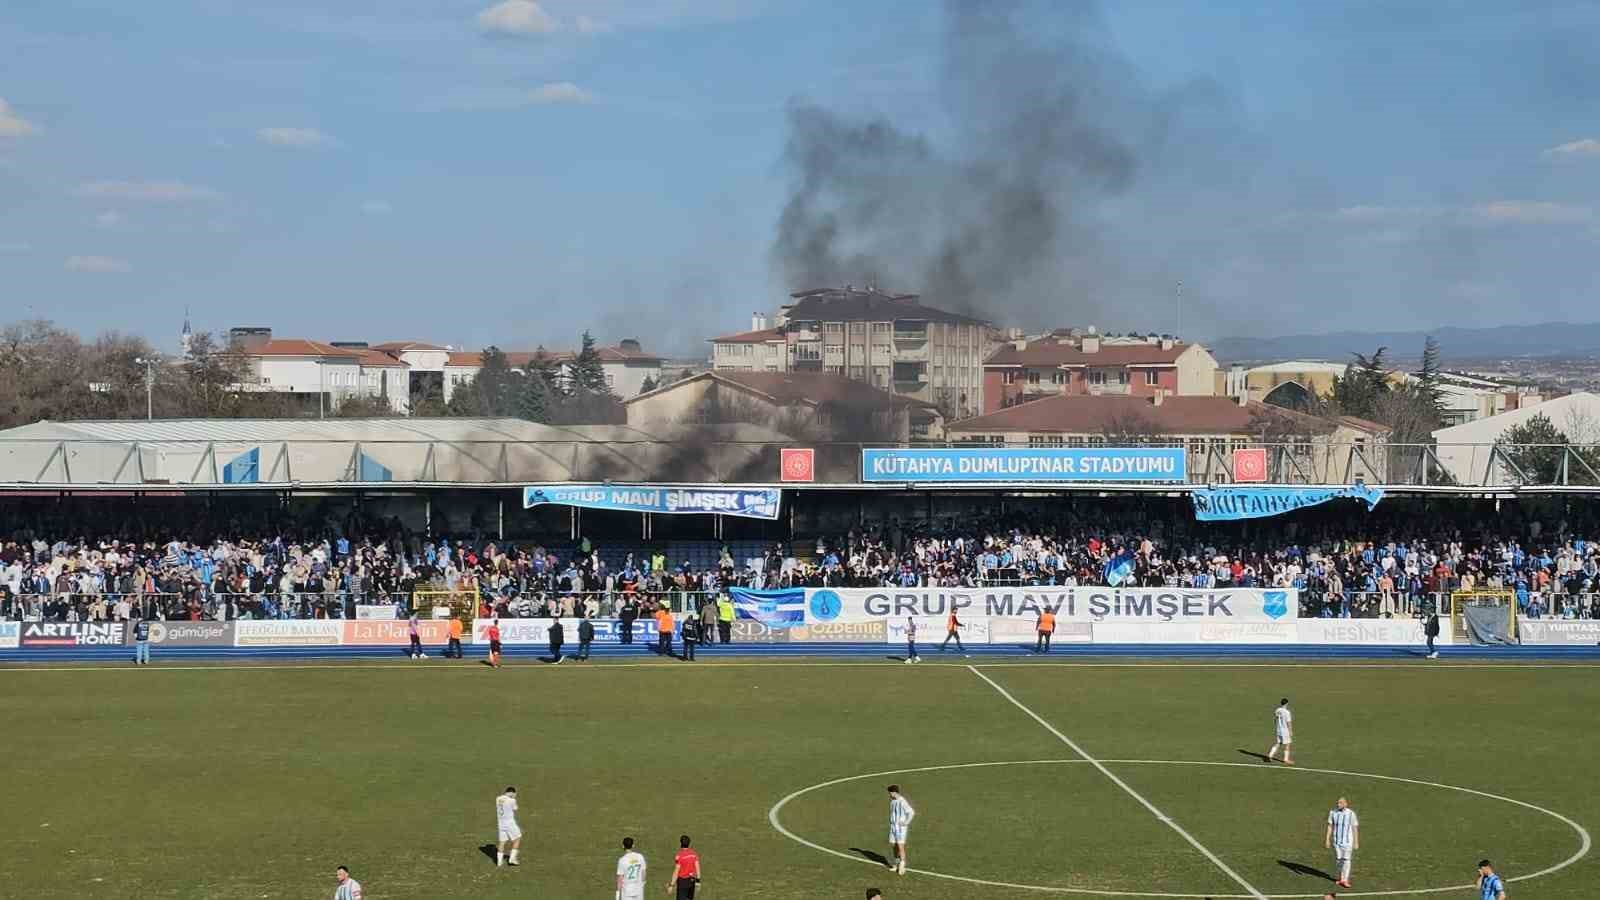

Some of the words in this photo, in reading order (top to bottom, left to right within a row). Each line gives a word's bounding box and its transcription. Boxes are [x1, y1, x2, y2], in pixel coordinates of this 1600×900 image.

[873, 453, 953, 474] KÜTAHYA
[959, 456, 1073, 473] DUMLUPINAR
[1079, 456, 1175, 473] STADYUMU
[555, 490, 605, 502] GRUP
[611, 489, 660, 507] MAVİ
[666, 490, 740, 511] ŞİMŞEK
[864, 593, 972, 616] GRUP
[986, 590, 1075, 616] MAVİ
[1089, 590, 1233, 622] ŞİMŞEK
[25, 623, 123, 637] ARTLINE
[354, 624, 372, 639] La
[75, 636, 123, 645] HOME
[627, 864, 641, 880] 27
